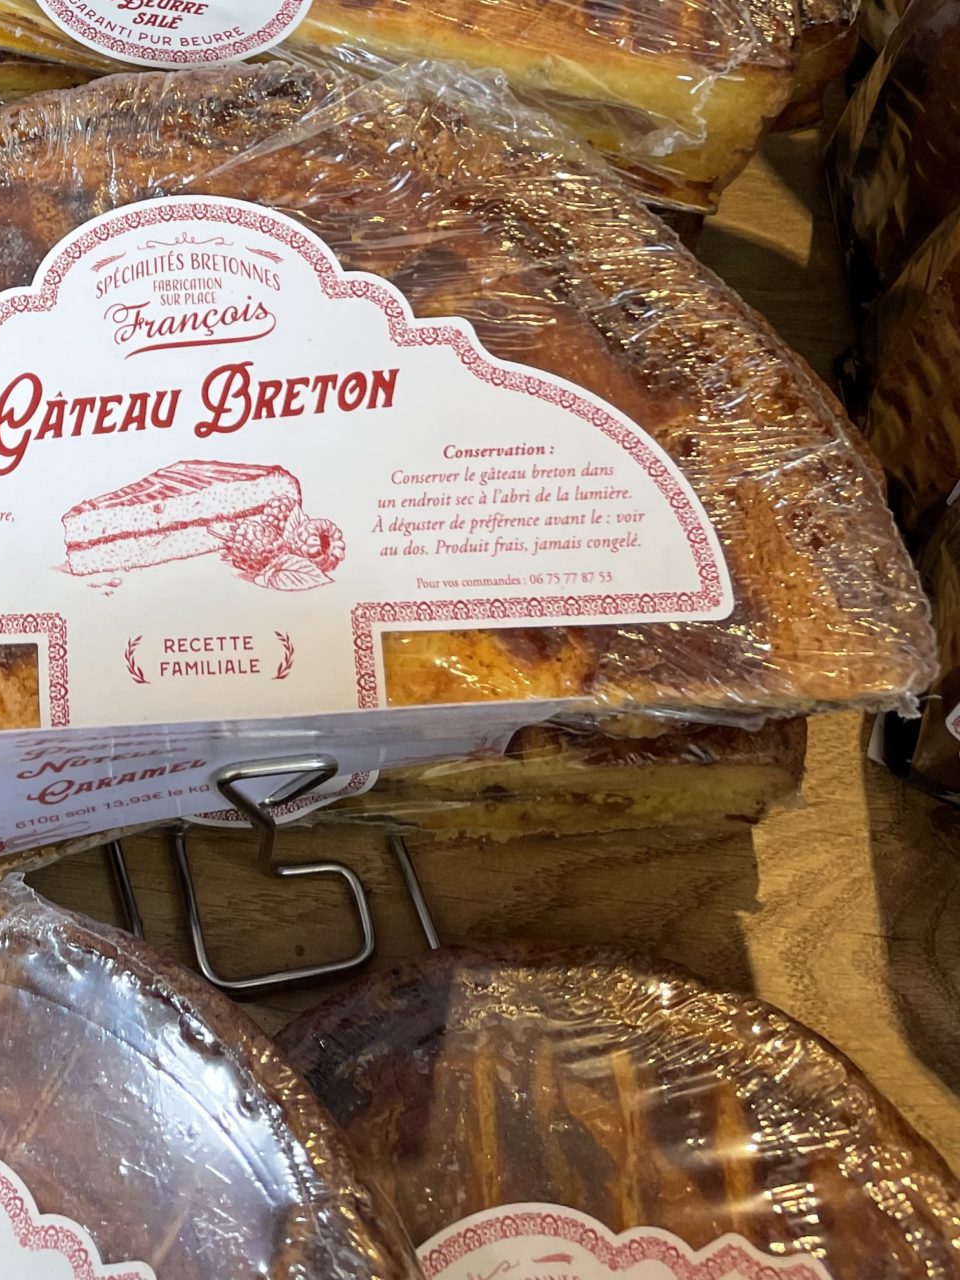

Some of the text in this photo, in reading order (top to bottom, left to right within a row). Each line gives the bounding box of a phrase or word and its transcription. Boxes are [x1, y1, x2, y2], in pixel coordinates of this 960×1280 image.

[132, 12, 183, 30] SALÉ
[138, 32, 172, 46] PUR
[180, 26, 245, 47] BEURRE
[95, 251, 281, 299] SPÉCIALITÉS BRETONNES
[152, 277, 222, 293] FABRICATION
[160, 292, 216, 305] SUR PLACE
[104, 295, 276, 359] François
[194, 362, 399, 438] BRETON
[391, 462, 614, 486] Conserver le gâteau breton dans
[378, 498, 395, 509] un
[401, 492, 450, 508] endroit
[456, 496, 474, 506] sec
[478, 491, 487, 504] à
[535, 487, 551, 502] de
[556, 486, 569, 502] la
[574, 484, 632, 501] lumière.
[372, 516, 384, 533] À
[388, 514, 444, 536] déguster
[449, 513, 464, 530] de
[469, 512, 540, 534] préférence
[544, 512, 585, 525] avant
[617, 512, 645, 523] voir
[380, 532, 642, 557] au dos. Produit frais, jamais congelé.
[416, 578, 440, 589] Pour
[442, 578, 459, 588] vos
[530, 573, 544, 584] 06
[547, 573, 560, 584] 75
[564, 572, 576, 584] 77
[581, 572, 594, 582] 87
[599, 572, 612, 582] 53
[164, 636, 253, 653] RECETTE
[160, 658, 260, 677] FAMILIALE
[26, 759, 208, 804] CARAMEL
[16, 815, 59, 830] 610g
[65, 806, 97, 818] soit
[168, 788, 183, 797] le
[189, 784, 210, 793] kg
